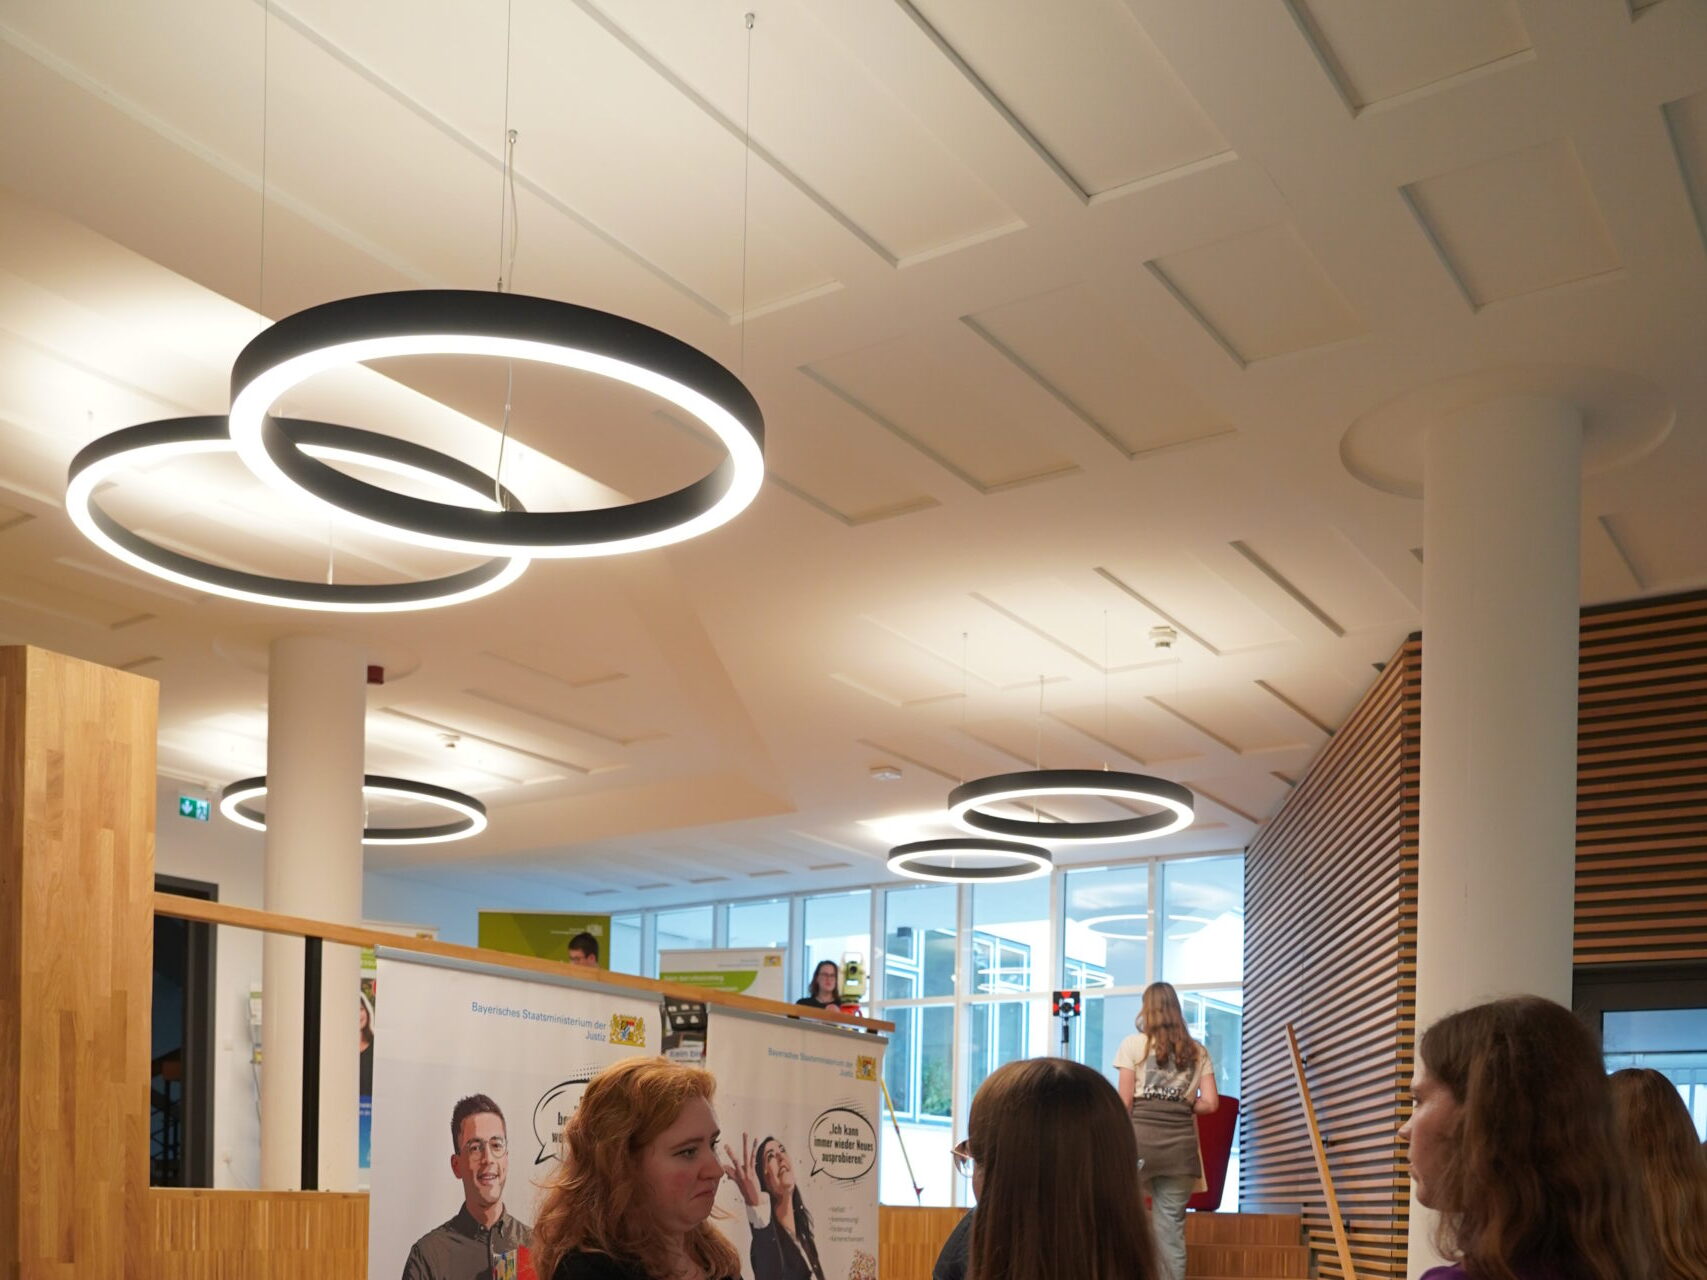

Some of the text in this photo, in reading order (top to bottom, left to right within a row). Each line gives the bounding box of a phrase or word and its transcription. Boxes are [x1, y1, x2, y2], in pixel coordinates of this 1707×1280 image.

[471, 1001, 607, 1031] Bayerisches Staatsministerium der
[585, 1032, 607, 1042] Justiz
[844, 1124, 859, 1136] kann
[814, 1136, 873, 1151] immer wieder Neues
